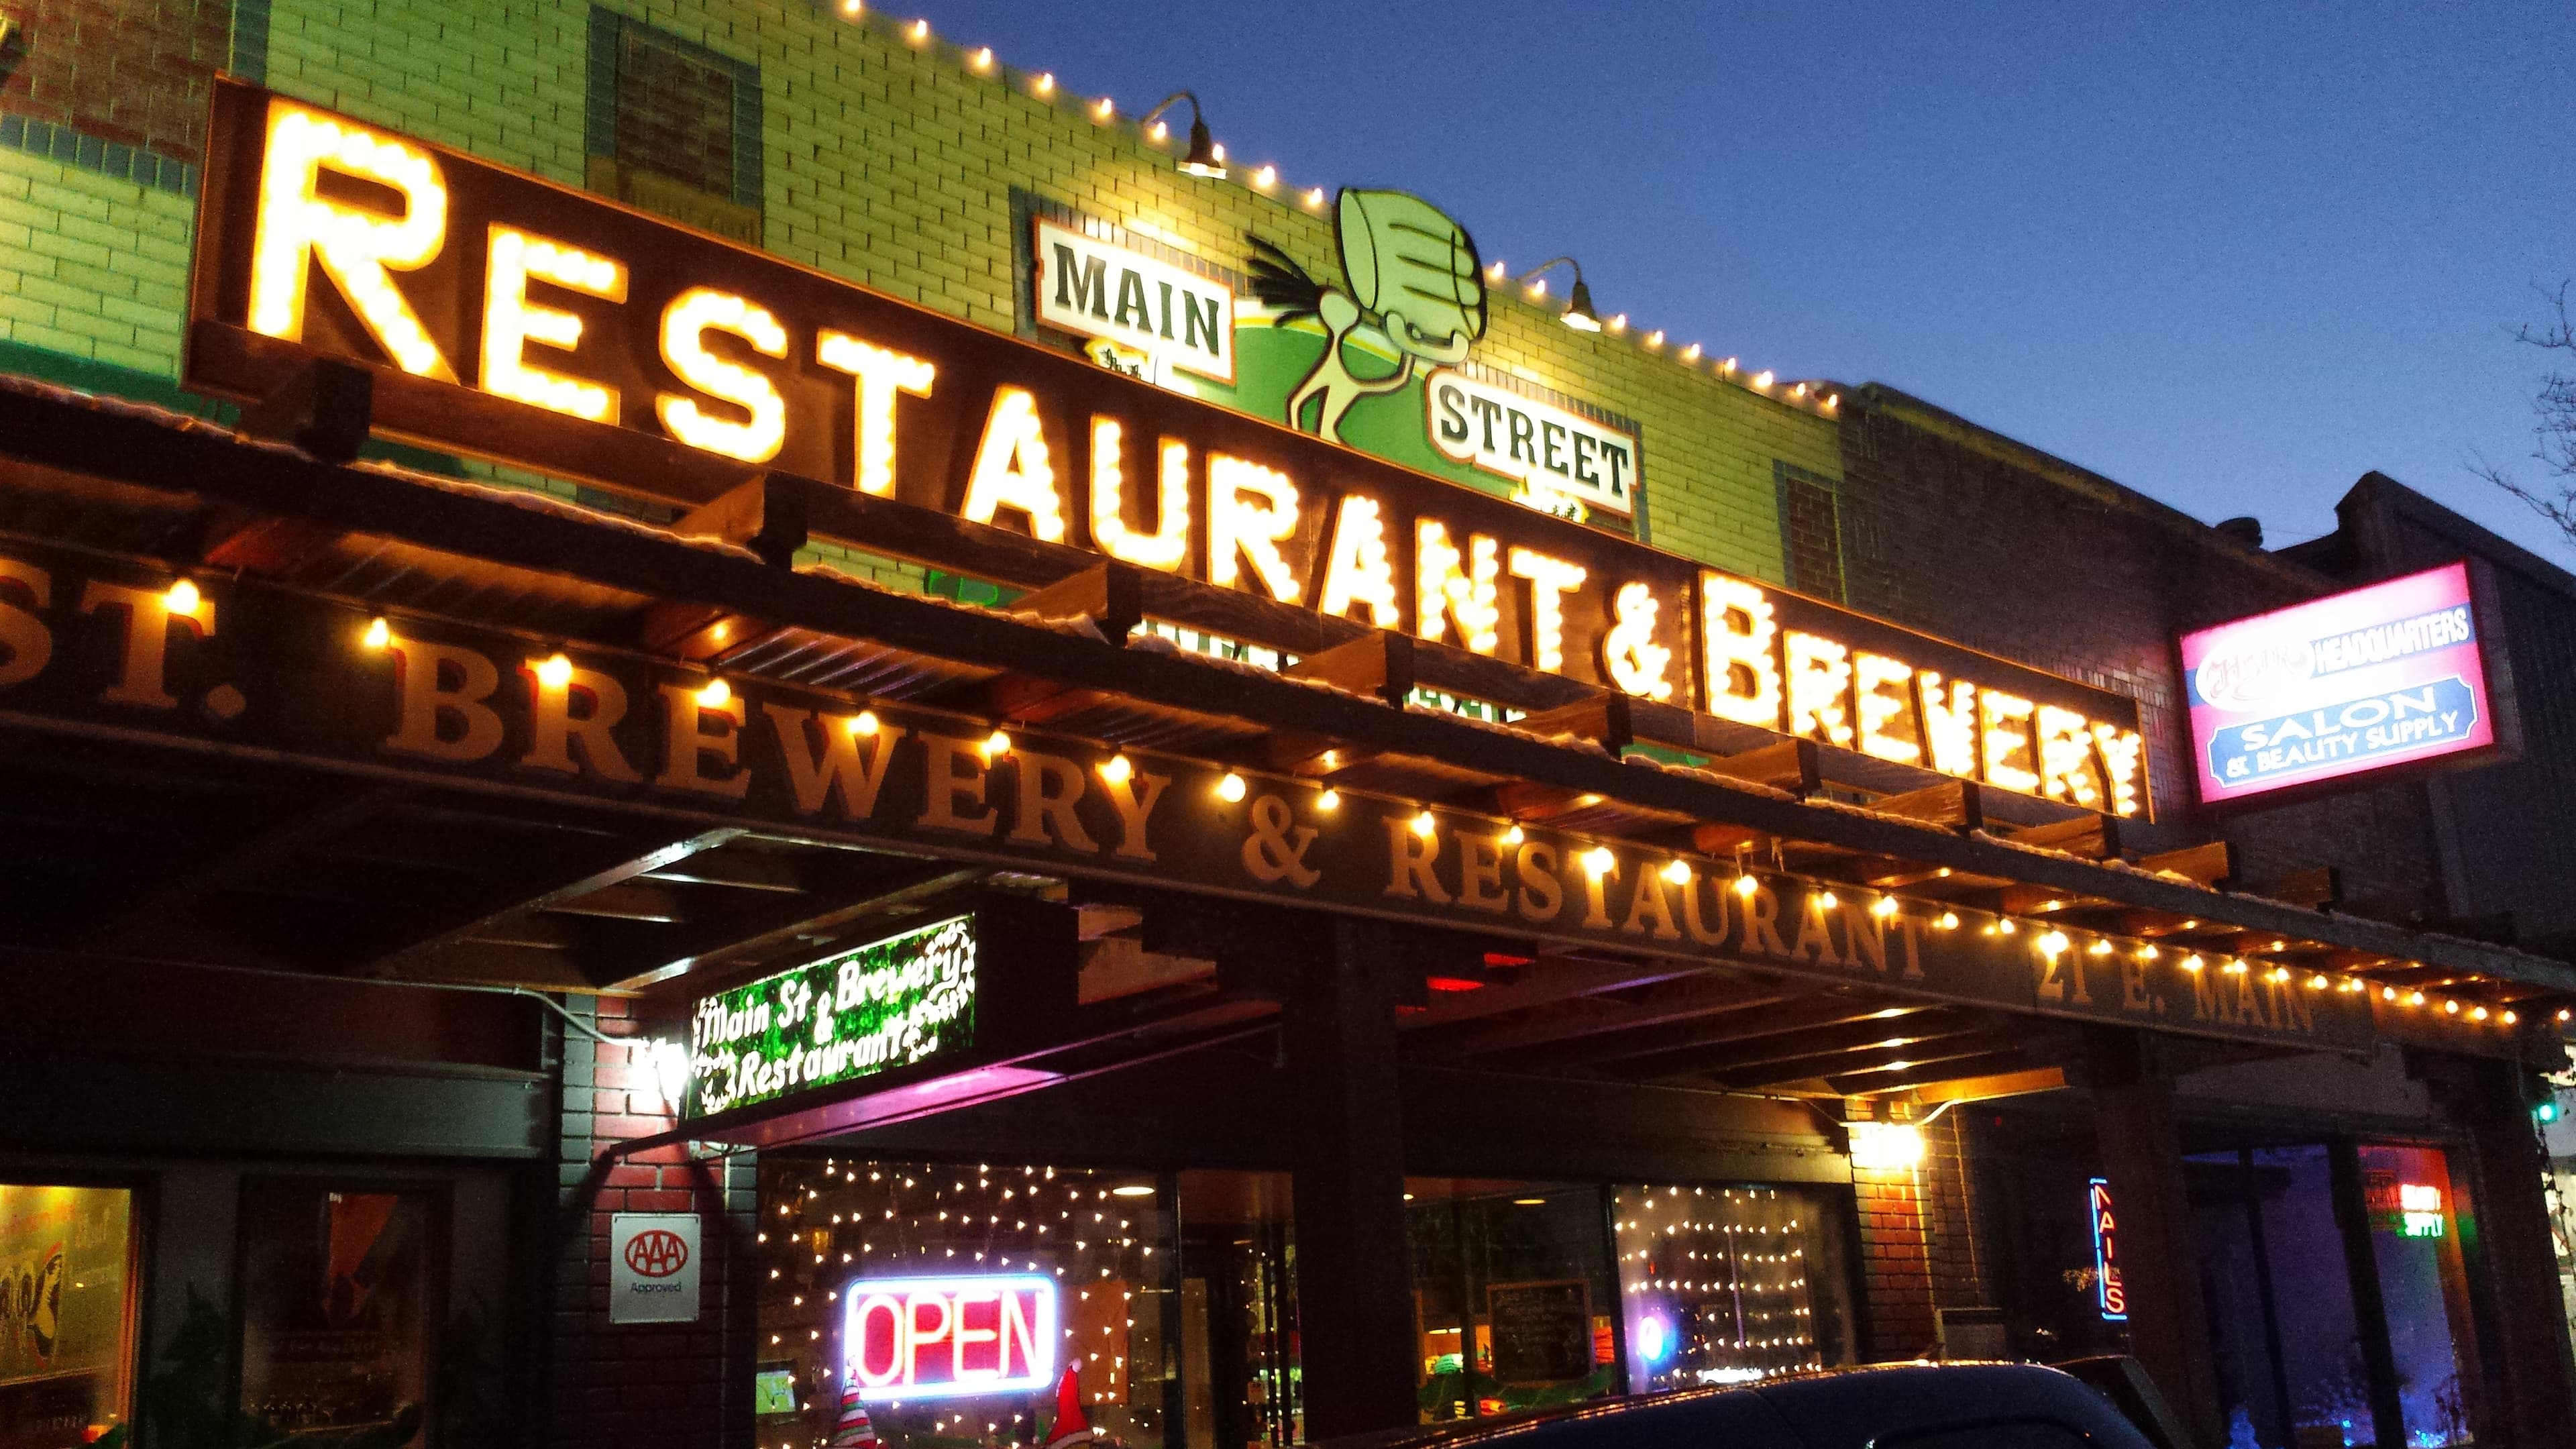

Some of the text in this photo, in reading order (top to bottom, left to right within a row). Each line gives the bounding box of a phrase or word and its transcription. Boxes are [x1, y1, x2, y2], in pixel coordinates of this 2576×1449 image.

[1053, 241, 1220, 358] MAIN
[247, 98, 2141, 818] RESTAURANT & BREWERY
[1439, 384, 1629, 497] STREET
[2316, 606, 2470, 674] HEADQUARTERS
[2226, 710, 2459, 778] & BEAUTY SUPPLY
[2240, 686, 2436, 751] SALON
[378, 634, 1171, 861] BREWERY
[1241, 794, 1322, 889] &
[1382, 815, 1931, 982] RESTAURANT
[2190, 963, 2313, 1031] MAIN
[702, 996, 770, 1049] Main
[835, 945, 962, 1012] Brewery
[814, 991, 835, 1045] &
[737, 1022, 909, 1098] Restaurant
[629, 1232, 684, 1276] AAA
[631, 1281, 682, 1295] Approved
[857, 1292, 1042, 1387] OPEN
